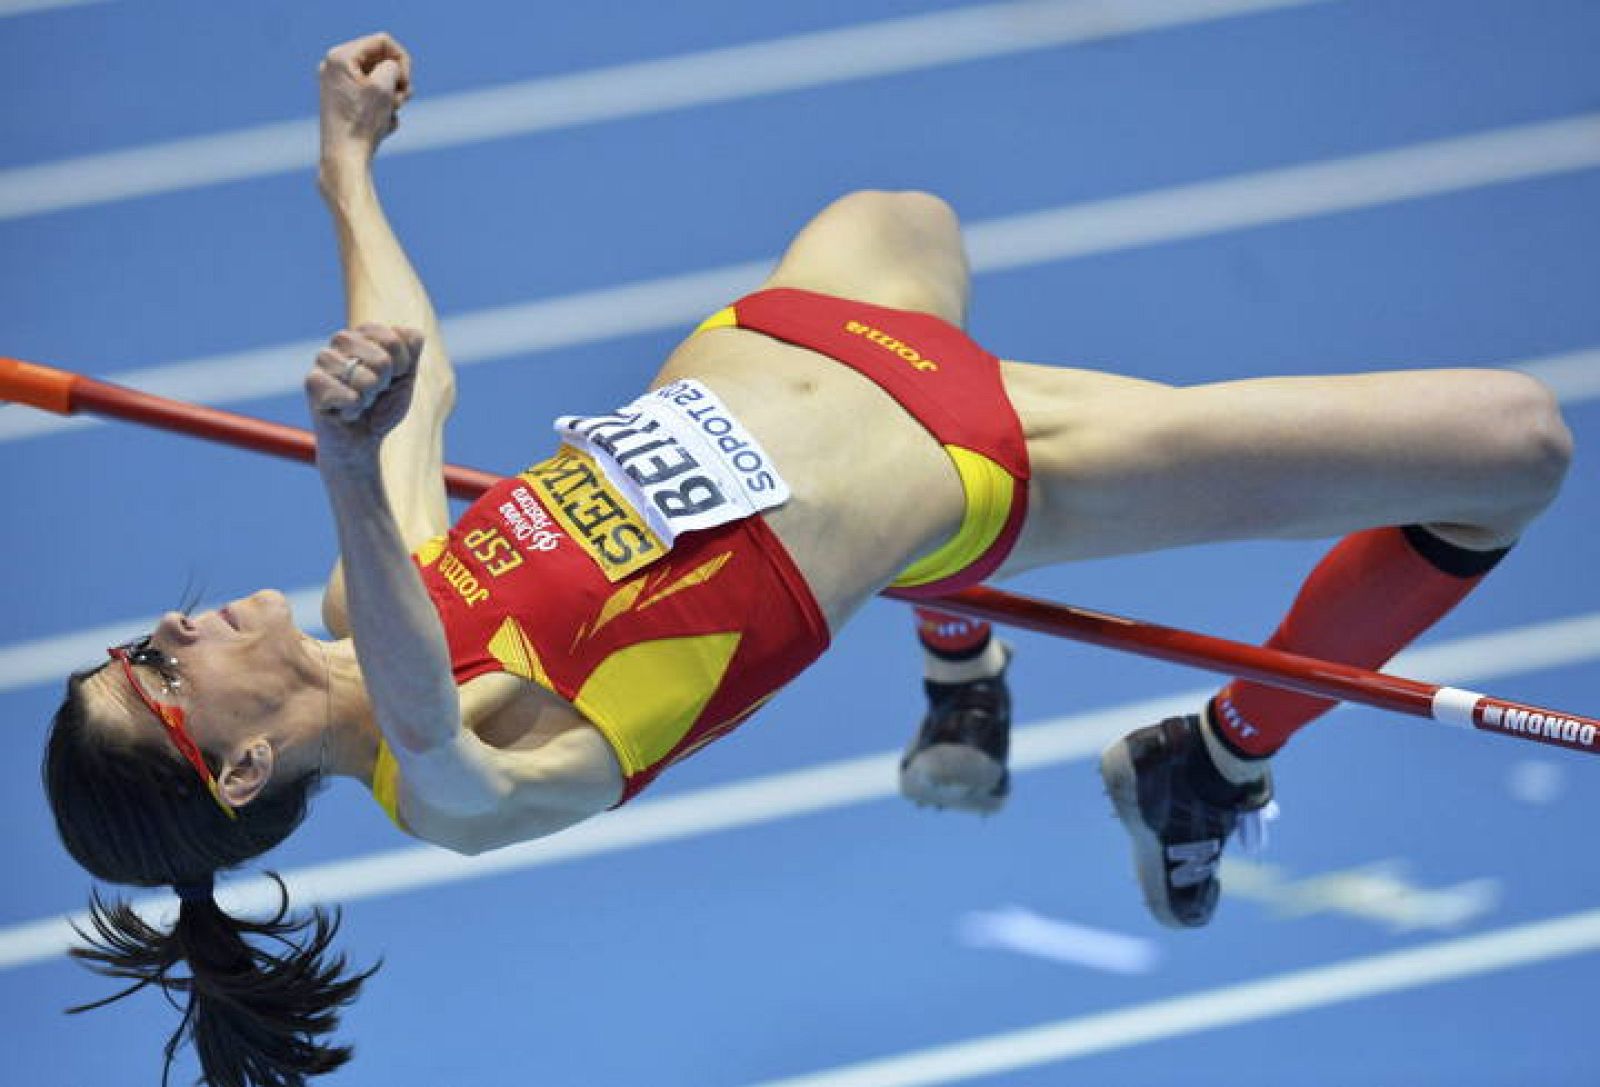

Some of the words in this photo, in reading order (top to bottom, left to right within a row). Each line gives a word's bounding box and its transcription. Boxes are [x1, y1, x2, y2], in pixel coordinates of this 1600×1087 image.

[687, 405, 776, 492] SOPOT
[463, 528, 524, 577] ESP
[1504, 707, 1598, 746] MONDO
